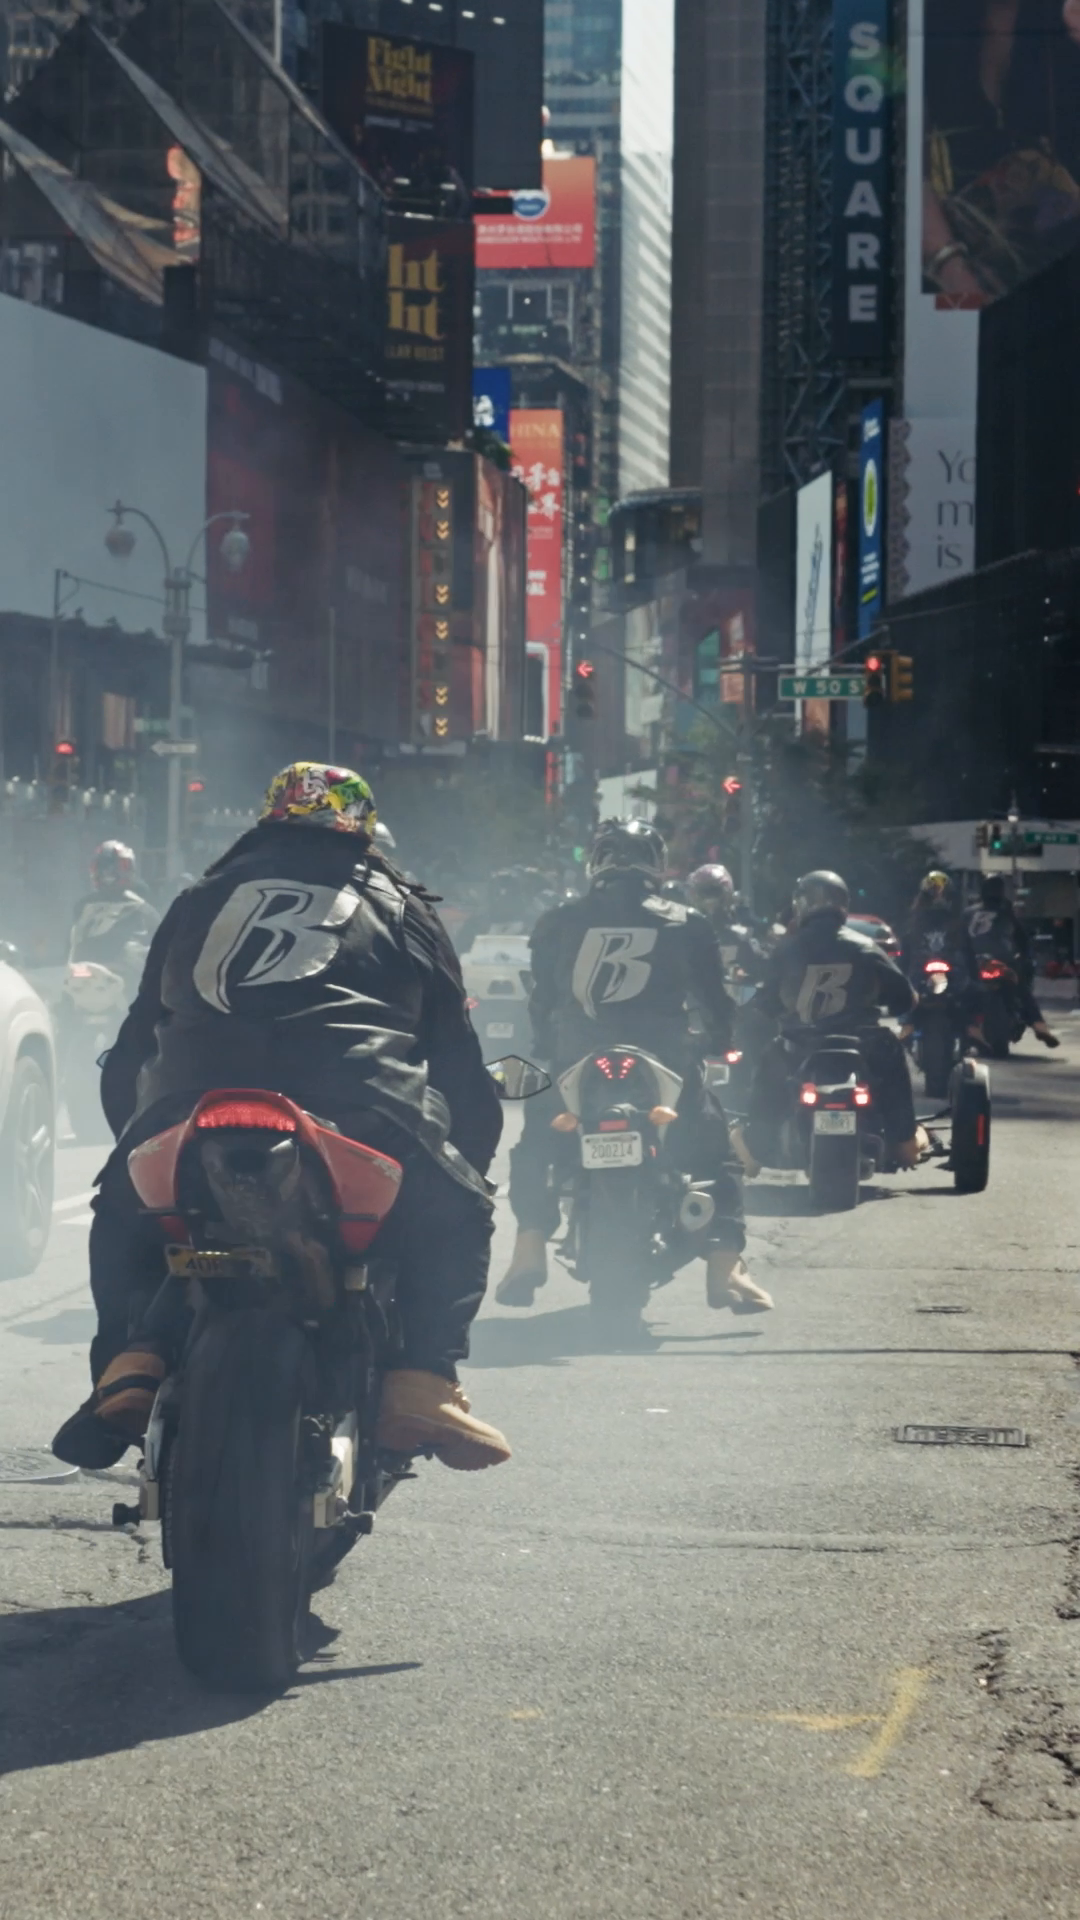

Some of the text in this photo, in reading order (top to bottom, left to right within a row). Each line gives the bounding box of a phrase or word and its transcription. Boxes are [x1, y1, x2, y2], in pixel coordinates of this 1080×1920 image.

[367, 36, 432, 73] Fight
[365, 66, 432, 103] Night
[843, 20, 885, 322] SQUARE
[936, 534, 963, 570] is
[792, 680, 807, 695] W
[816, 680, 841, 695] 50
